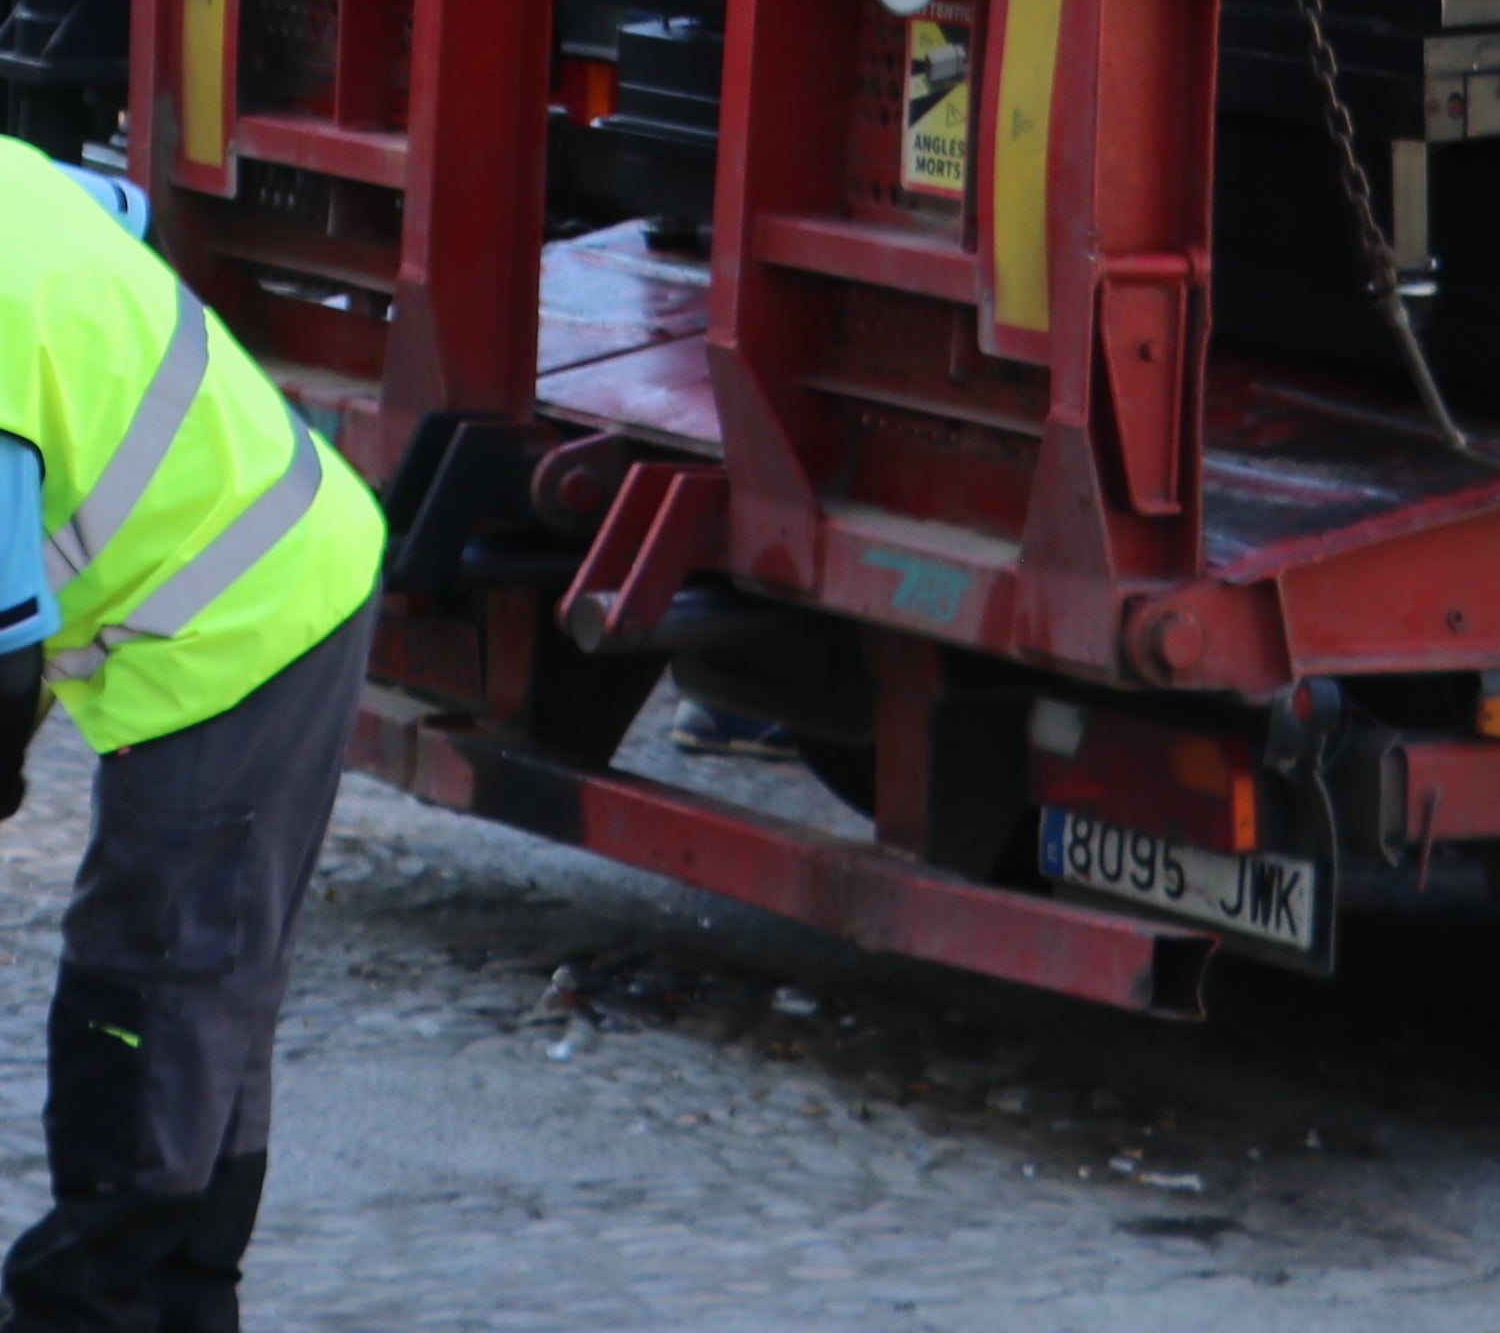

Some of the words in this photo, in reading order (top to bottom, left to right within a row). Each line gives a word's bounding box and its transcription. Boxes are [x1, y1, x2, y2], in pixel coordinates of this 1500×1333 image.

[913, 132, 965, 159] ANGLES
[914, 156, 962, 181] MORTS
[1067, 819, 1188, 899] 8095
[1219, 854, 1301, 938] JWK
